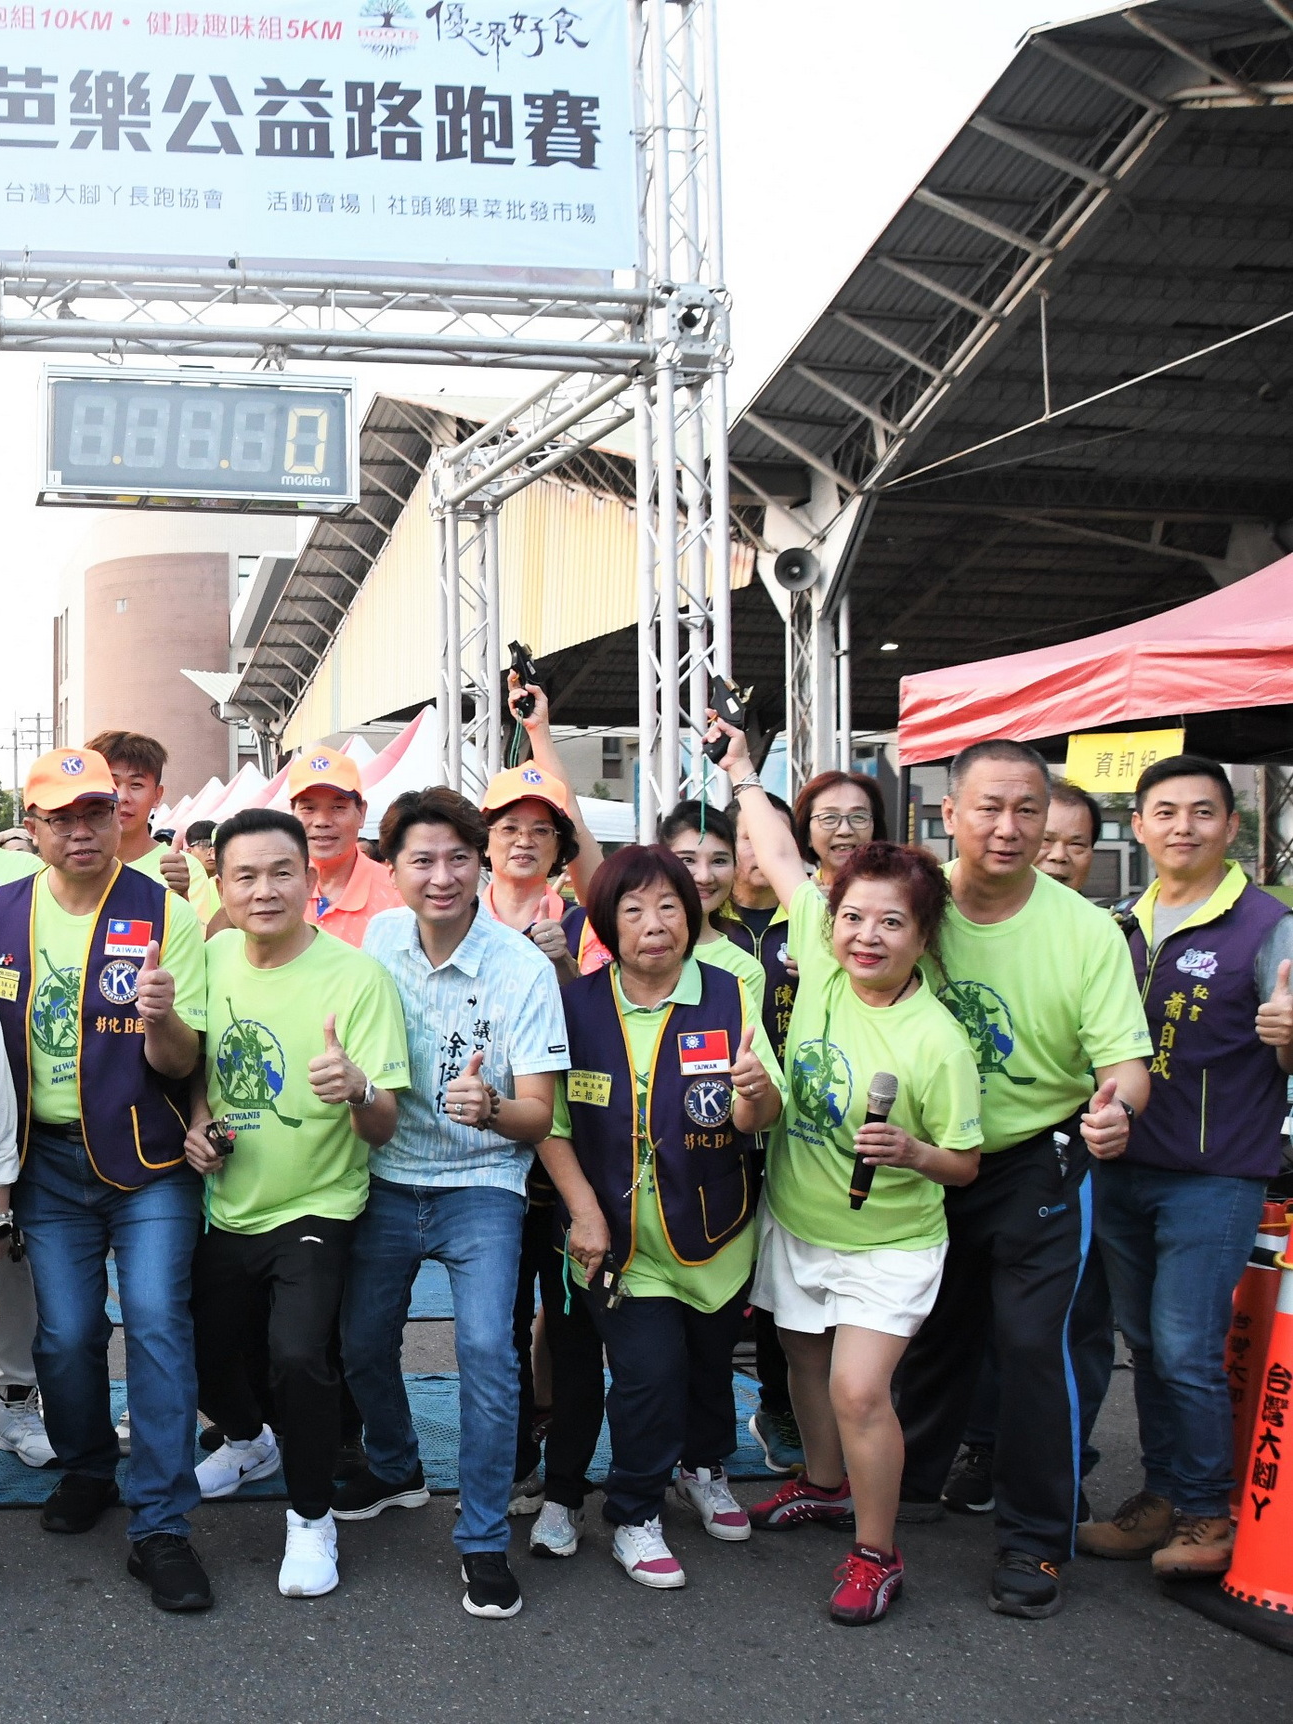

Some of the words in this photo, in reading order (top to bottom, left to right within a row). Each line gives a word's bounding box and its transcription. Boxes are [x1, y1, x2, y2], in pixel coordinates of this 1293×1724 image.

[281, 475, 331, 487] molten
[111, 946, 144, 954] TAIWAN
[107, 963, 136, 974] KIWANIS
[1148, 991, 1187, 1080] 蕭自成
[52, 1060, 77, 1074] KIWA
[693, 1063, 718, 1071] TAIWAN
[50, 1072, 76, 1085] Marat
[691, 1081, 725, 1094] KIWANIS
